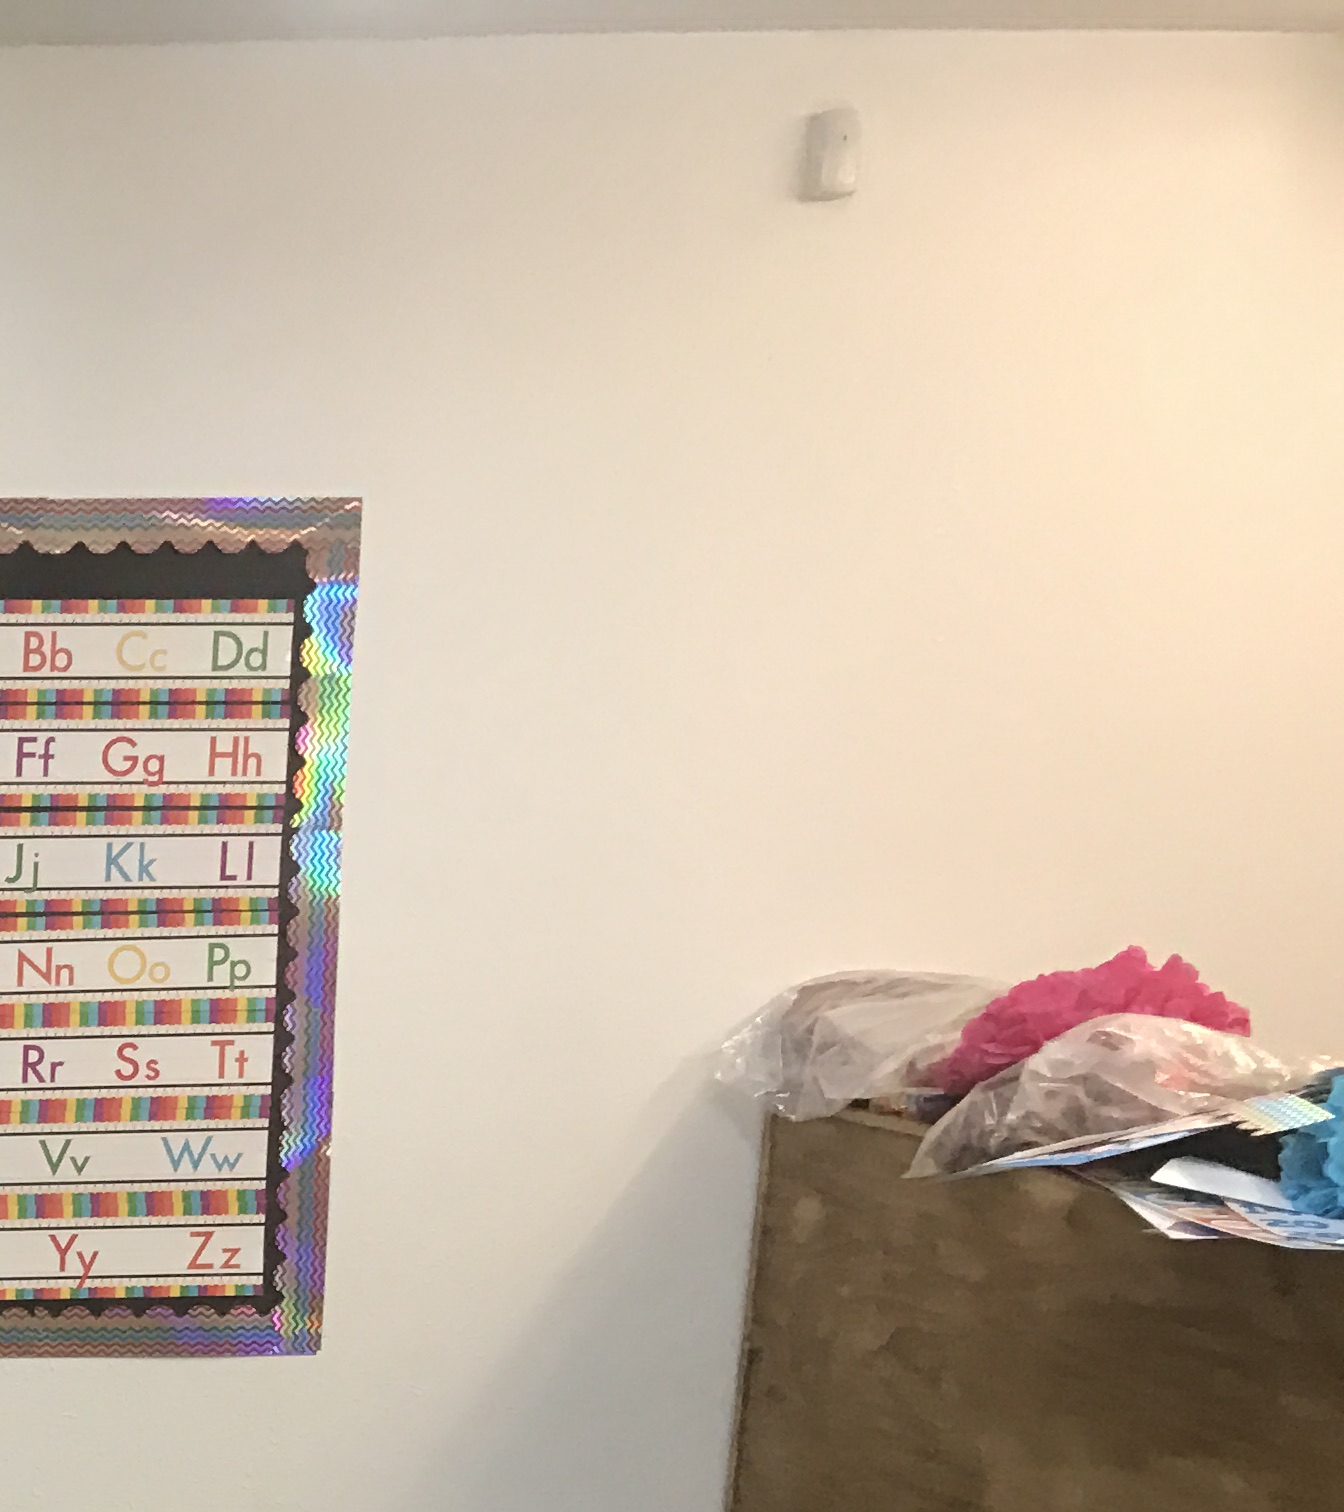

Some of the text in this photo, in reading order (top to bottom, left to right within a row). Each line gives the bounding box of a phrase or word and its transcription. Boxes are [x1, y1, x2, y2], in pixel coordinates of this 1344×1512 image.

[22, 631, 73, 673] Bb
[116, 630, 168, 672] Cc
[211, 630, 269, 672] Dd
[15, 736, 56, 778] Ff
[101, 736, 165, 787] Gg
[208, 736, 262, 777] Hh
[4, 842, 40, 893] Jj
[104, 841, 157, 882] Kk
[219, 840, 254, 881] Ll
[16, 947, 74, 988] Nn
[108, 944, 171, 985] Oo
[207, 942, 251, 991] Pp
[22, 1044, 65, 1084] Rr
[114, 1042, 161, 1081] Ss
[211, 1040, 249, 1079] Tt
[39, 1139, 91, 1176] Vv
[161, 1136, 243, 1173] Ww
[48, 1233, 99, 1289] Yy
[186, 1231, 242, 1270] Zz
